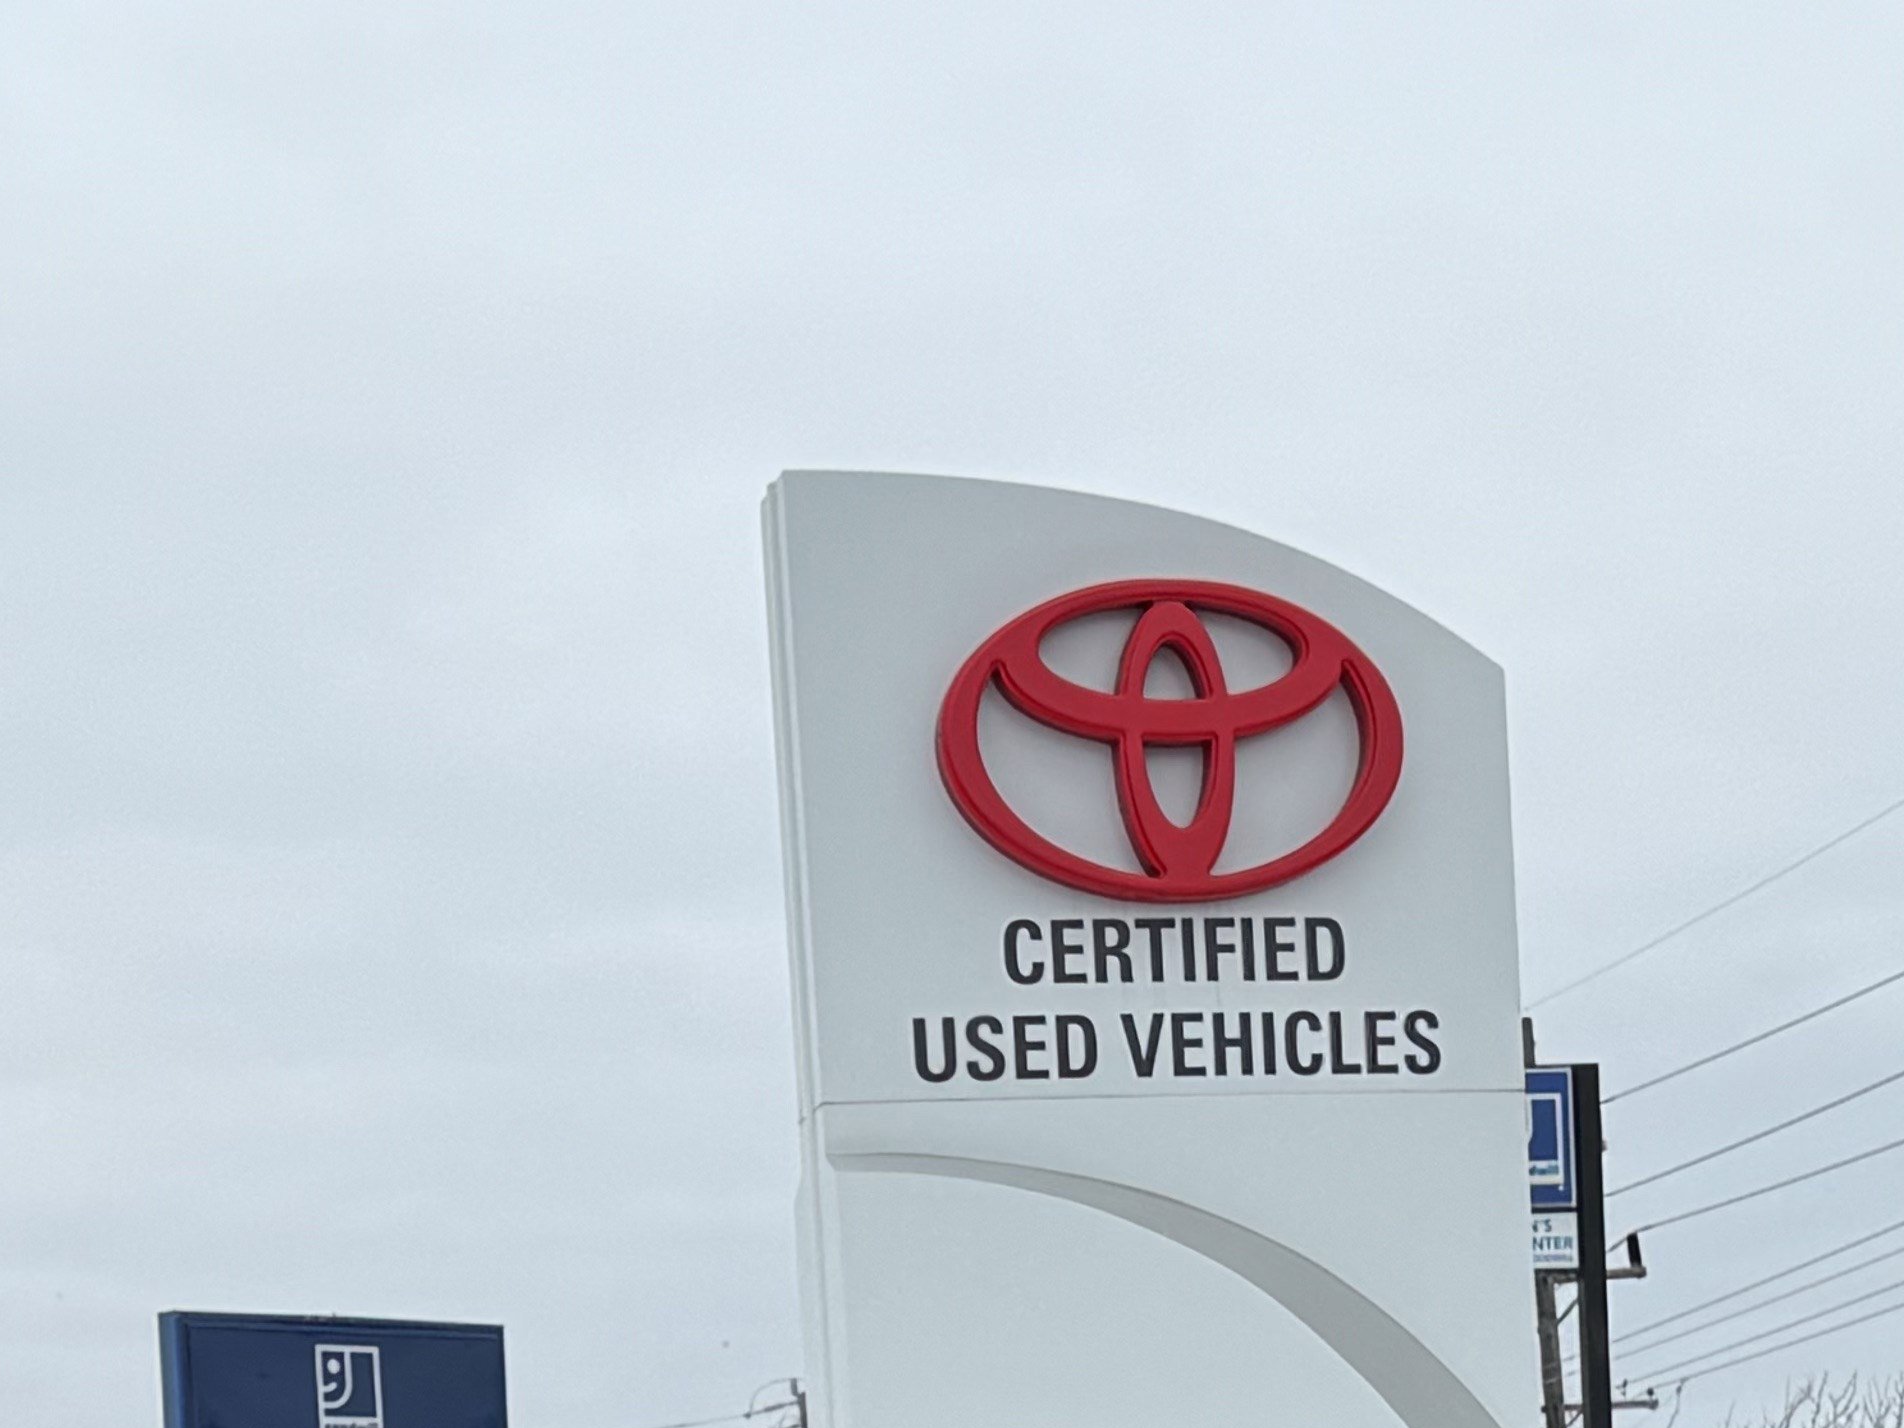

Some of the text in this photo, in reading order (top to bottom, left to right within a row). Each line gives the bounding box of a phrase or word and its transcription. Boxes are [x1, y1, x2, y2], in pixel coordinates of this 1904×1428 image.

[1003, 917, 1345, 985] CERTIFIED
[912, 1010, 1441, 1082] USED VEHICLES
[1532, 1236, 1573, 1250] NTER
